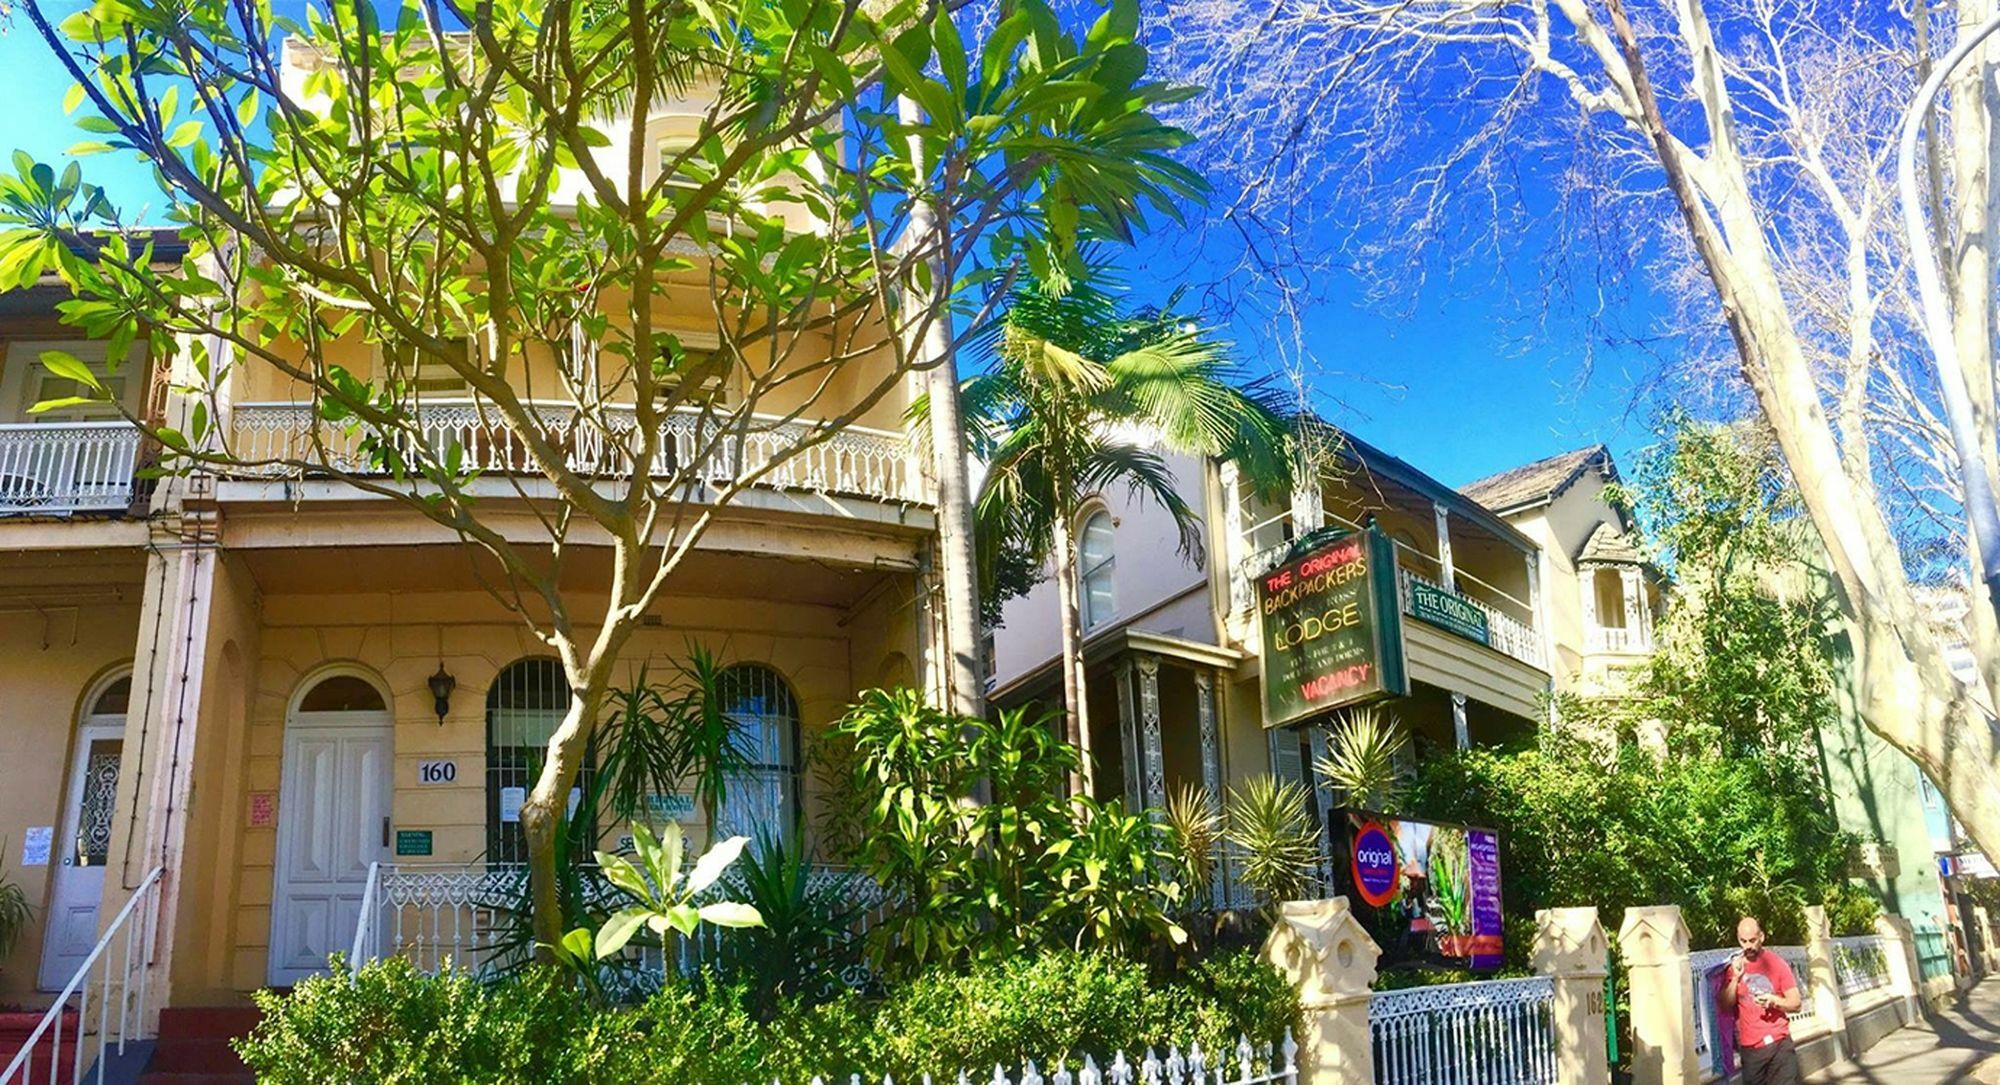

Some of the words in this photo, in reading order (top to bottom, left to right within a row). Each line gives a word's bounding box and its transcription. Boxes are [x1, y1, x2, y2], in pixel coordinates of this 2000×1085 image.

[1264, 556, 1367, 616] BACKPACKERS
[1267, 571, 1292, 592] THE
[1300, 544, 1361, 577] ORIGINAL
[1274, 602, 1360, 652] LODGE
[1416, 593, 1440, 610] THE
[1440, 595, 1485, 630] ORIGINAL
[1300, 663, 1369, 700] VACANCY
[421, 762, 456, 782] 160
[1586, 991, 1604, 1016] 162
